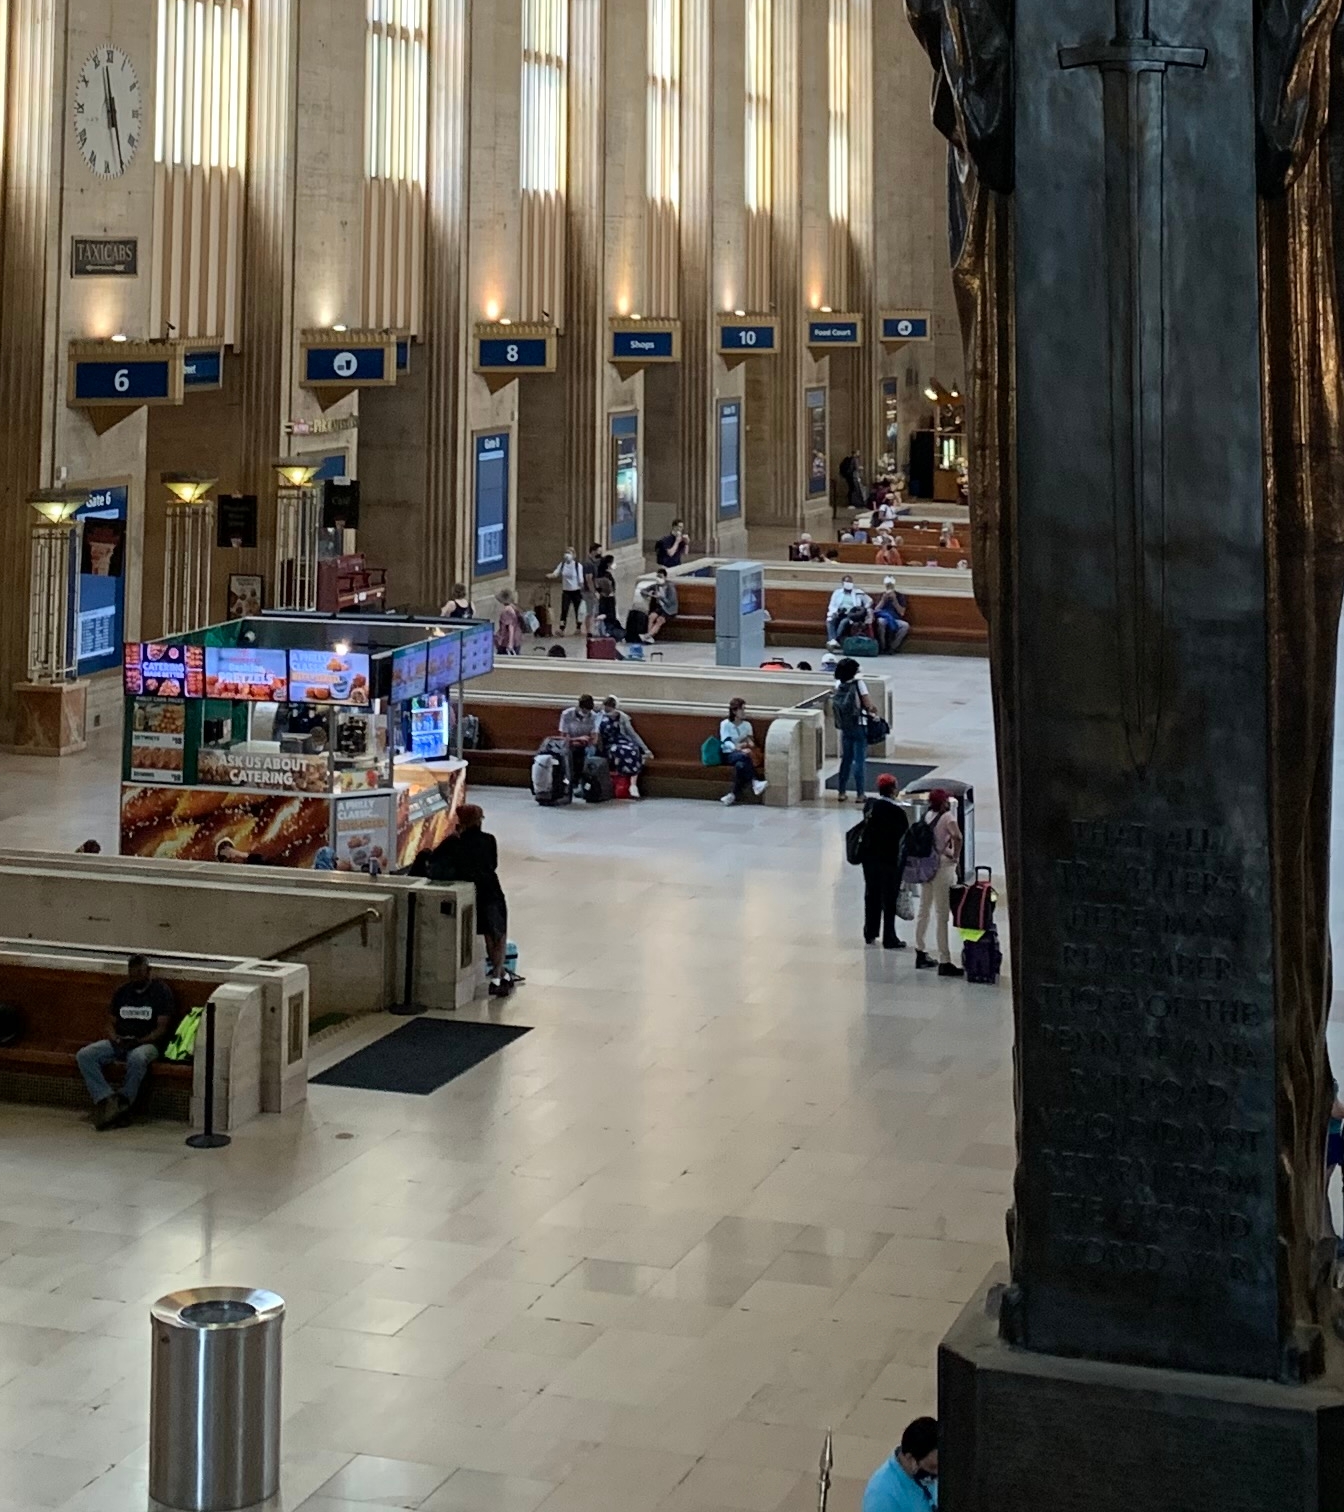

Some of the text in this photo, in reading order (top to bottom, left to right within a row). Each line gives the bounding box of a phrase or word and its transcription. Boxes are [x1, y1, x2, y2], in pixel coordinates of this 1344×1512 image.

[77, 243, 133, 262] TAXICABS
[739, 331, 756, 345] 10
[814, 328, 852, 337] Food Court
[630, 340, 655, 351] Shops
[506, 344, 518, 362] 8
[114, 369, 129, 392] 6
[105, 491, 112, 505] 6
[143, 661, 184, 672] CATERING
[219, 672, 277, 685] PRETZELS
[218, 753, 310, 772] ASK US ABOUT
